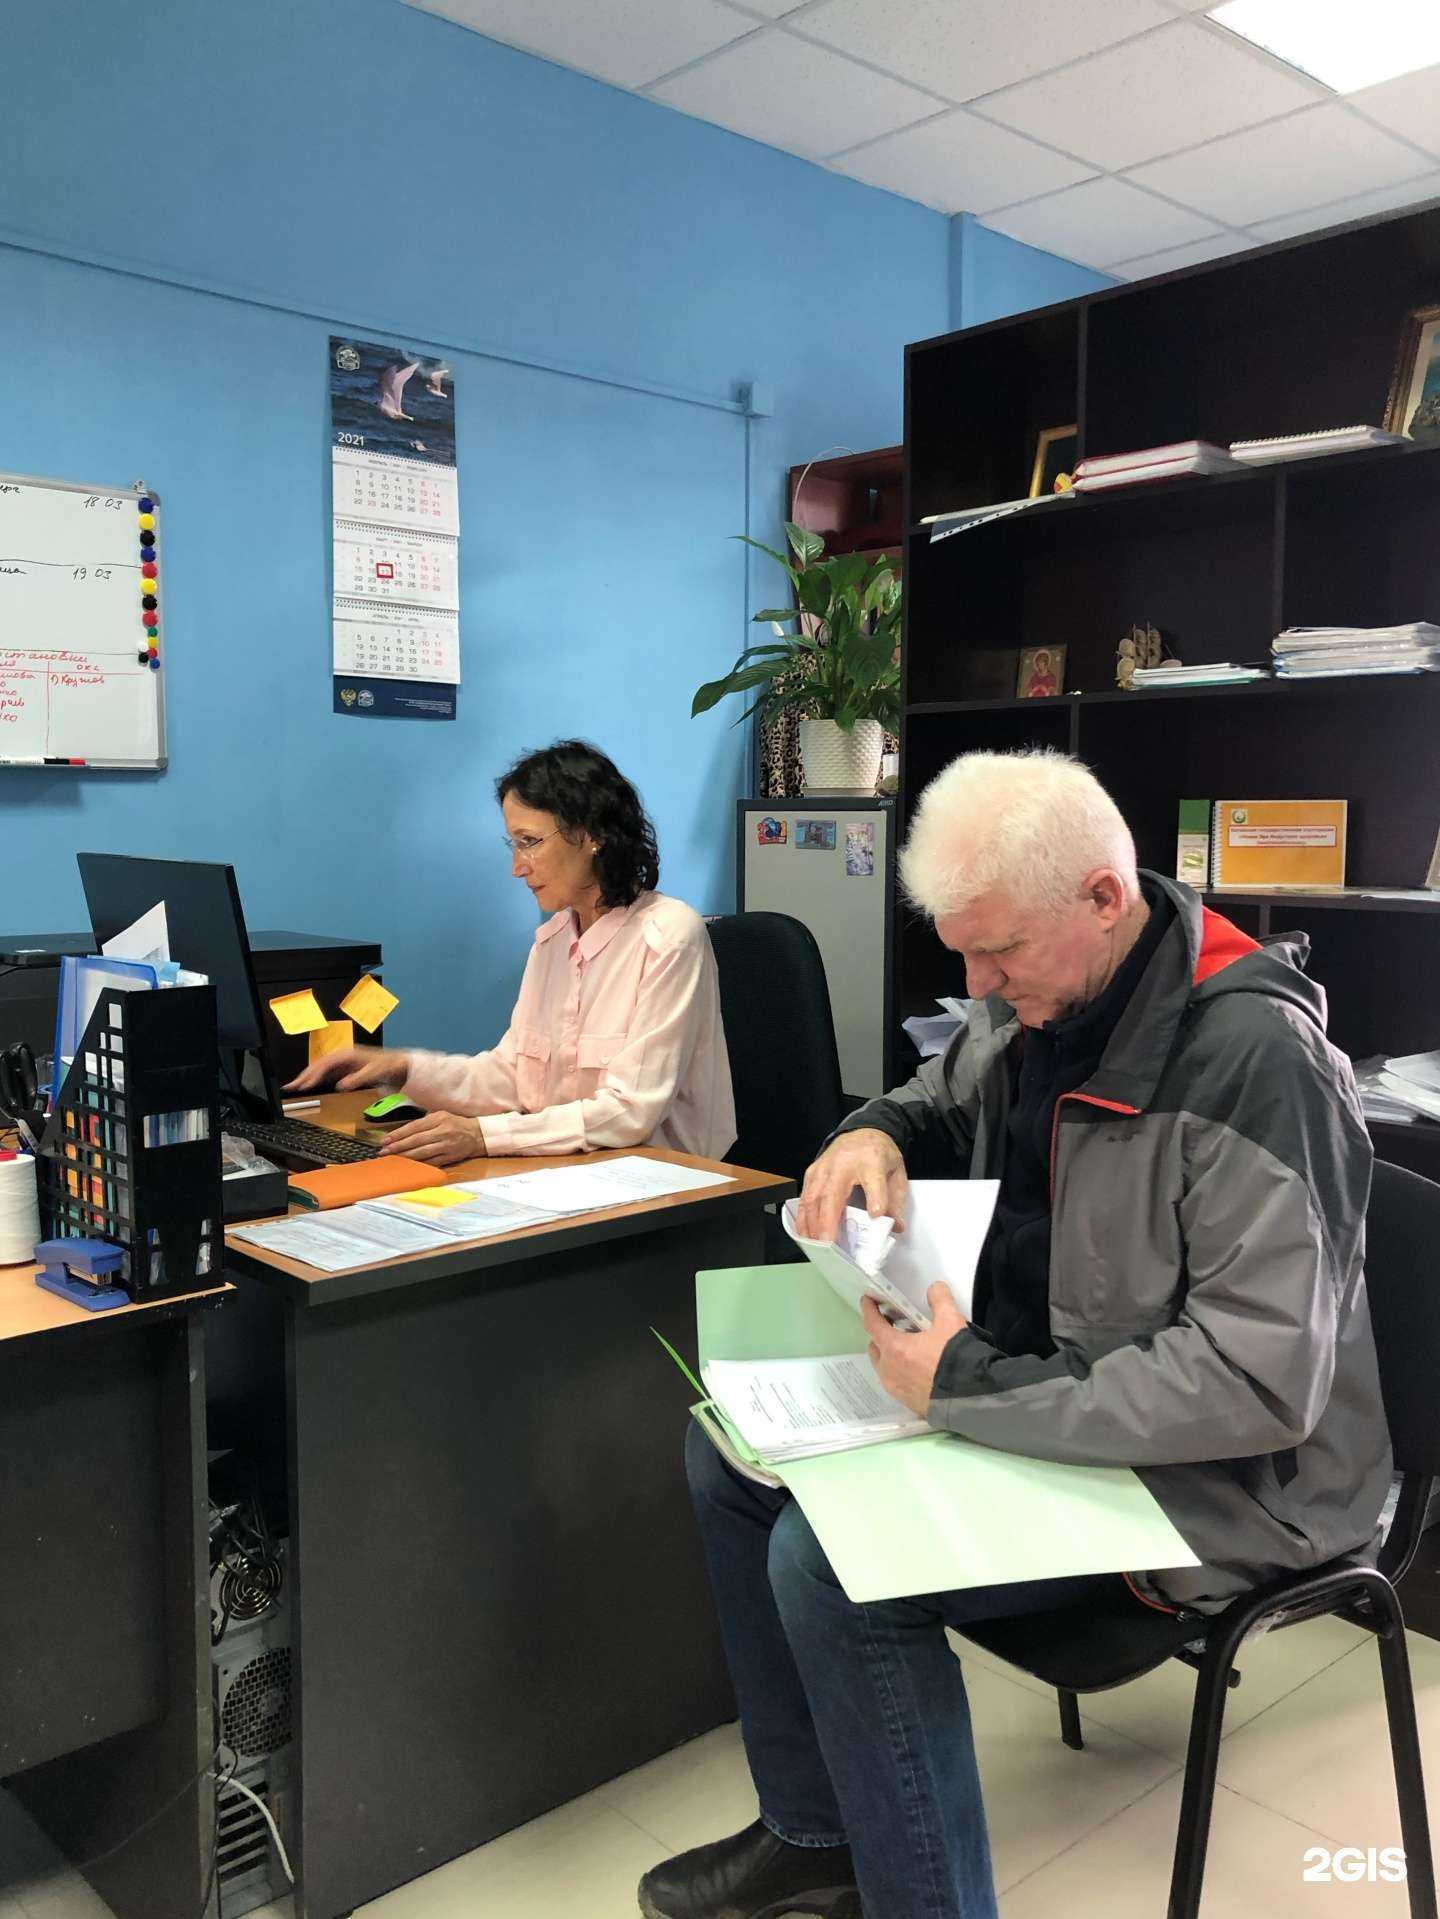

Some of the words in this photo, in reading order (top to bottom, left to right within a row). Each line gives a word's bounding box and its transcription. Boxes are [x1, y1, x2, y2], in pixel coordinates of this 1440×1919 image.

[338, 432, 364, 445] 2021
[83, 495, 100, 509] 18
[105, 498, 123, 511] 03
[72, 568, 87, 580] 19
[95, 568, 111, 580] 03
